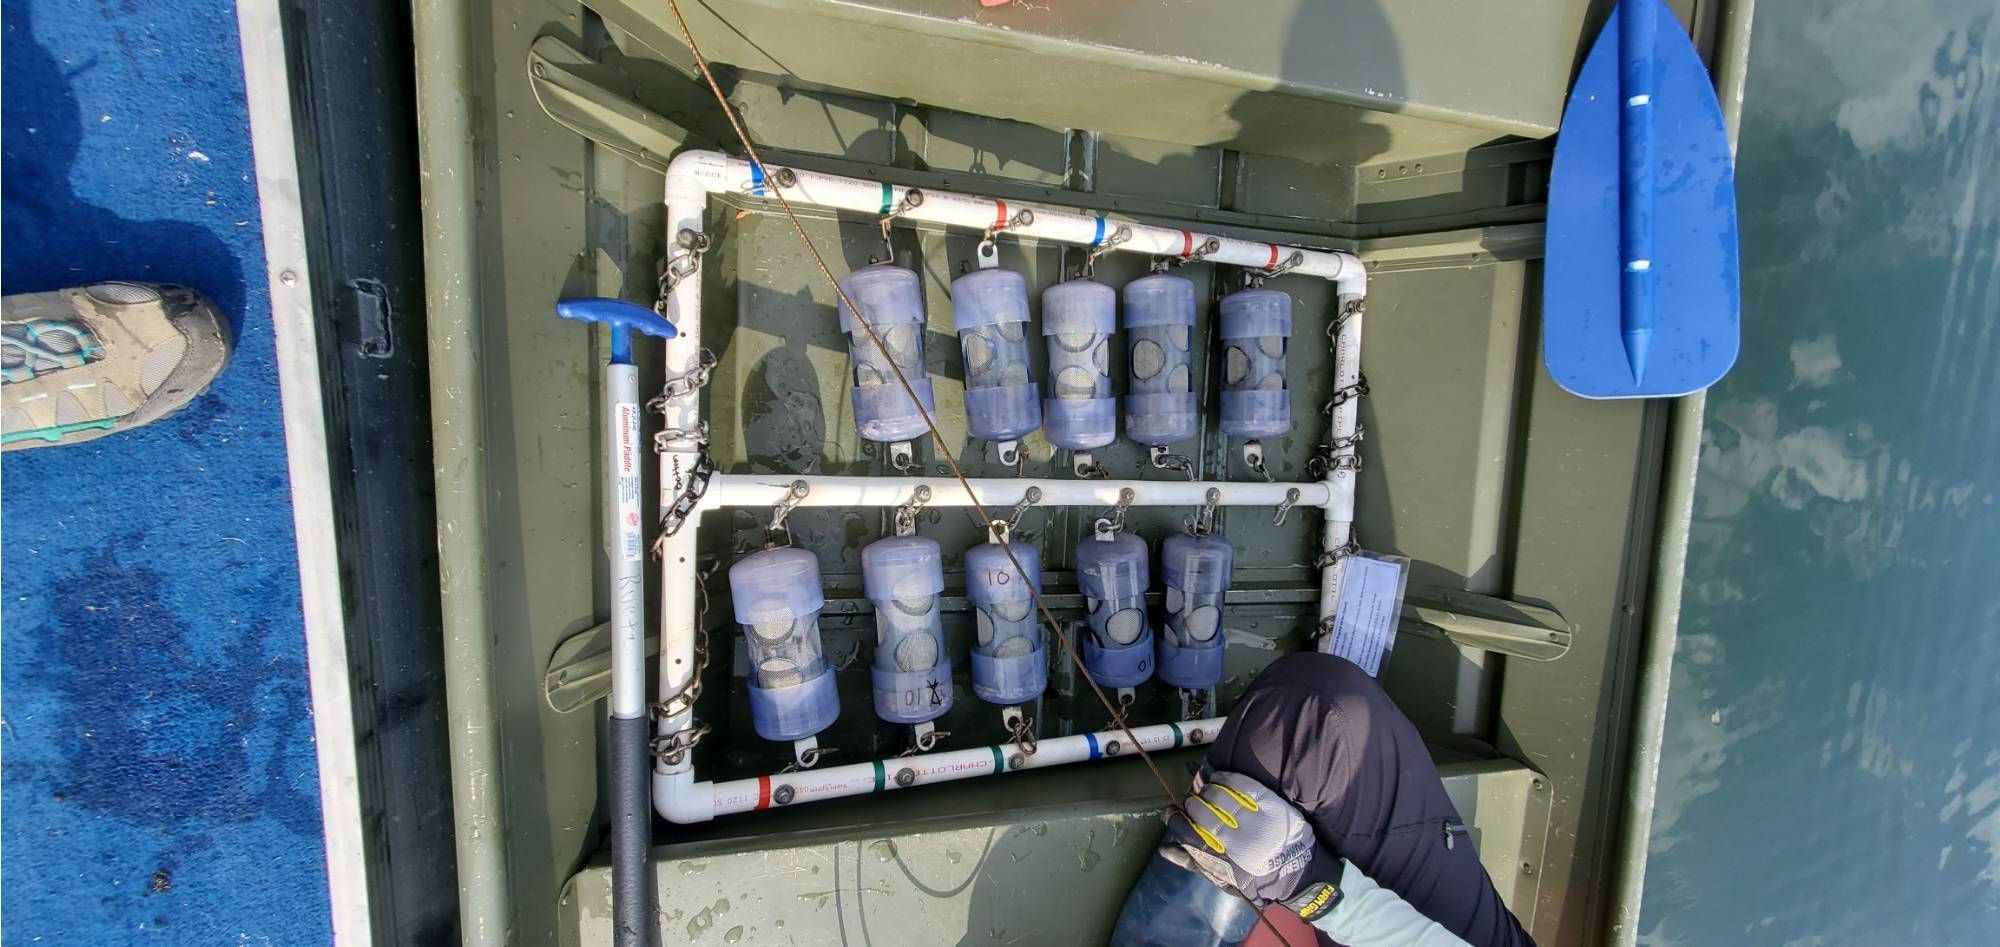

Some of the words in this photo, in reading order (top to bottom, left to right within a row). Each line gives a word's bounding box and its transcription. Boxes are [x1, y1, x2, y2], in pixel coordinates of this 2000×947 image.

[620, 406, 632, 444] Aluminum
[622, 445, 633, 473] Paddle
[988, 570, 1010, 586] 10
[1317, 884, 1335, 908] FIRM
[1299, 899, 1321, 918] GRIP
